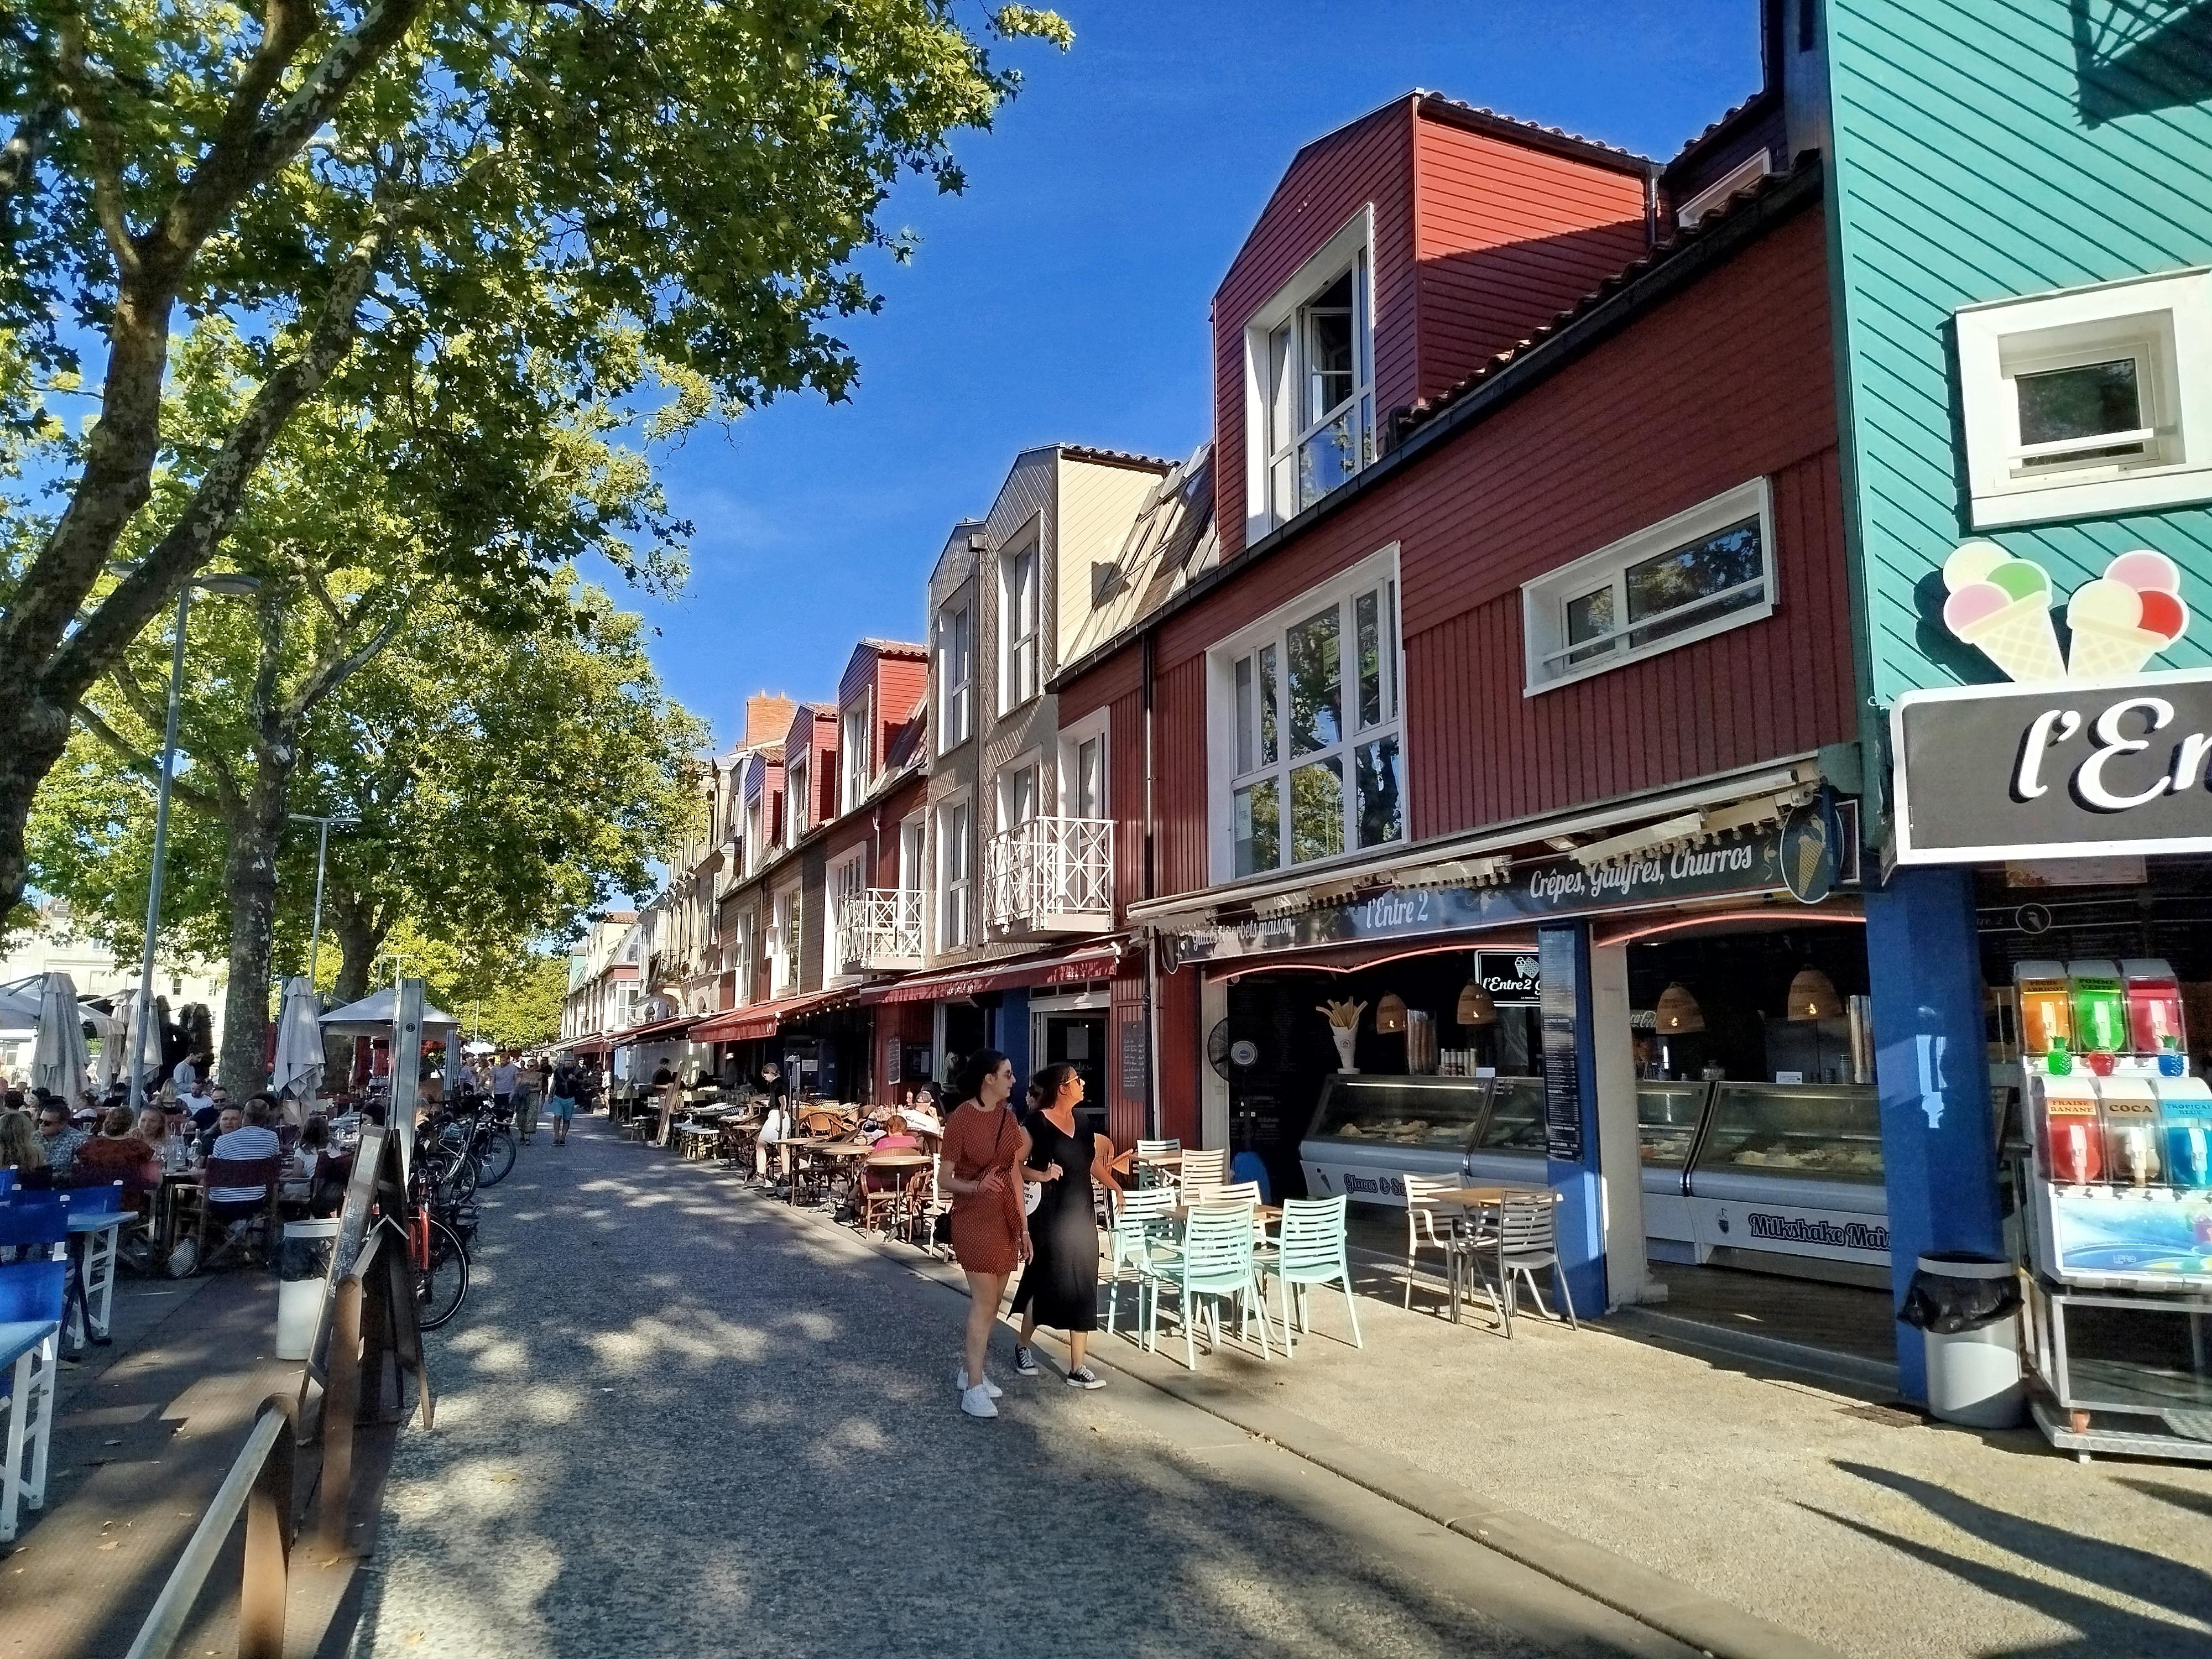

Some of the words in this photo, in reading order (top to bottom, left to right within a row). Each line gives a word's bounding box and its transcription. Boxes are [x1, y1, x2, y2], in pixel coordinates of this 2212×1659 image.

[1530, 868, 1585, 903] Crêpes,
[1671, 845, 1752, 879] Churros
[1366, 897, 1414, 928] l'Entre
[1417, 890, 1428, 921] 2
[1259, 918, 1292, 937] maison
[2109, 1104, 2153, 1113] COCA
[1344, 1173, 1378, 1194] Glaces
[1379, 1177, 1391, 1194] &
[1748, 1213, 1846, 1246] Milkshake
[1845, 1222, 1891, 1252] Mai
